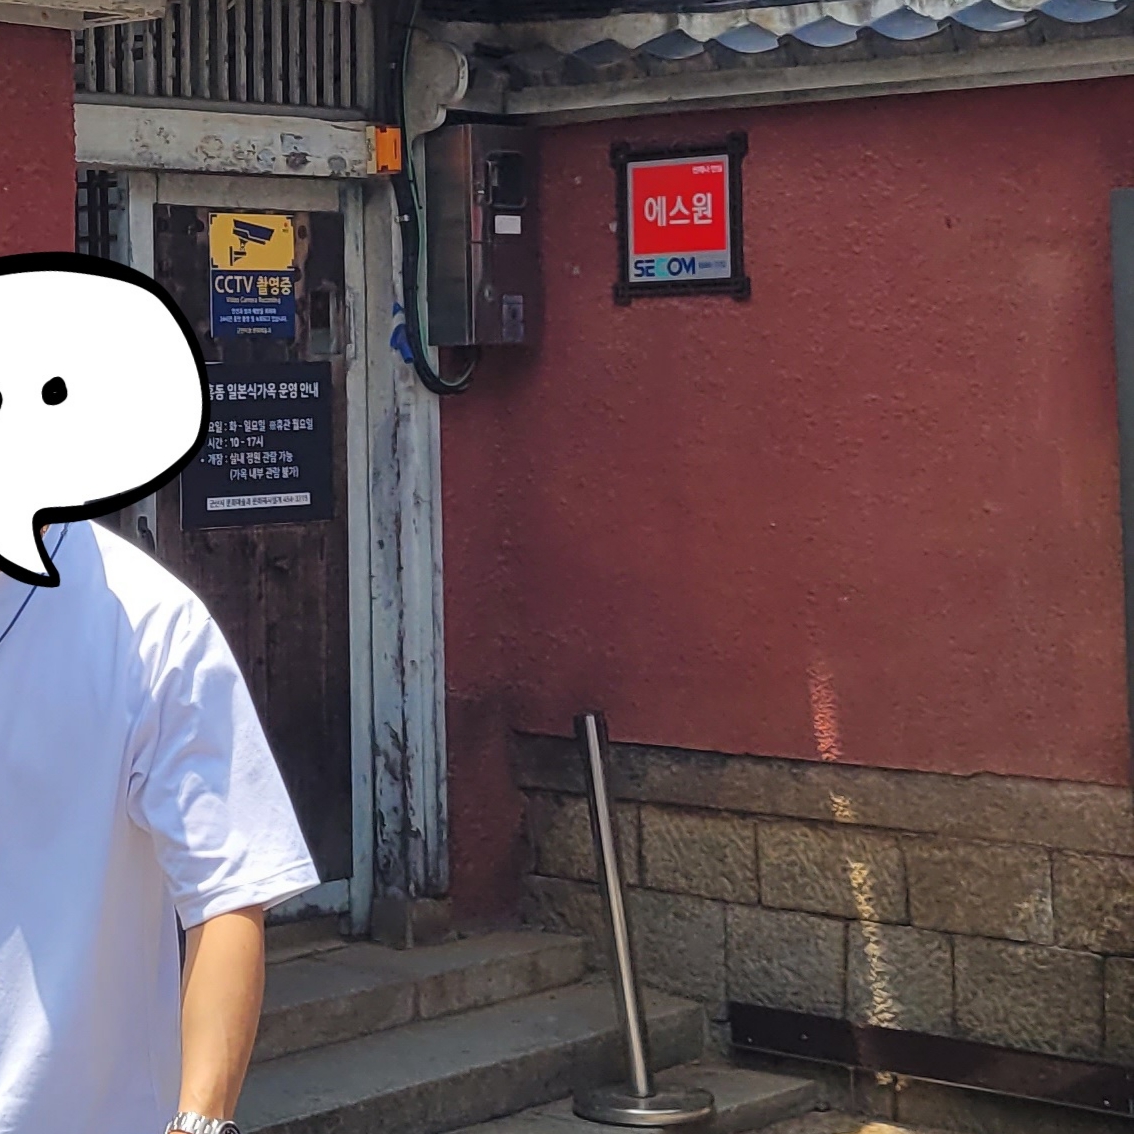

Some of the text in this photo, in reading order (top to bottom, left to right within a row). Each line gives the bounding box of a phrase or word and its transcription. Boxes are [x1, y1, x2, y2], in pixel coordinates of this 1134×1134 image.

[644, 192, 712, 227] 에스원
[634, 257, 696, 277] SECOM
[214, 275, 292, 295] CCTV 촬영중
[278, 382, 298, 398] 운영
[299, 381, 319, 399] 안내
[262, 451, 278, 463] 관람
[279, 450, 294, 463] 가능
[249, 467, 264, 480] 내부
[266, 467, 281, 479] 관람
